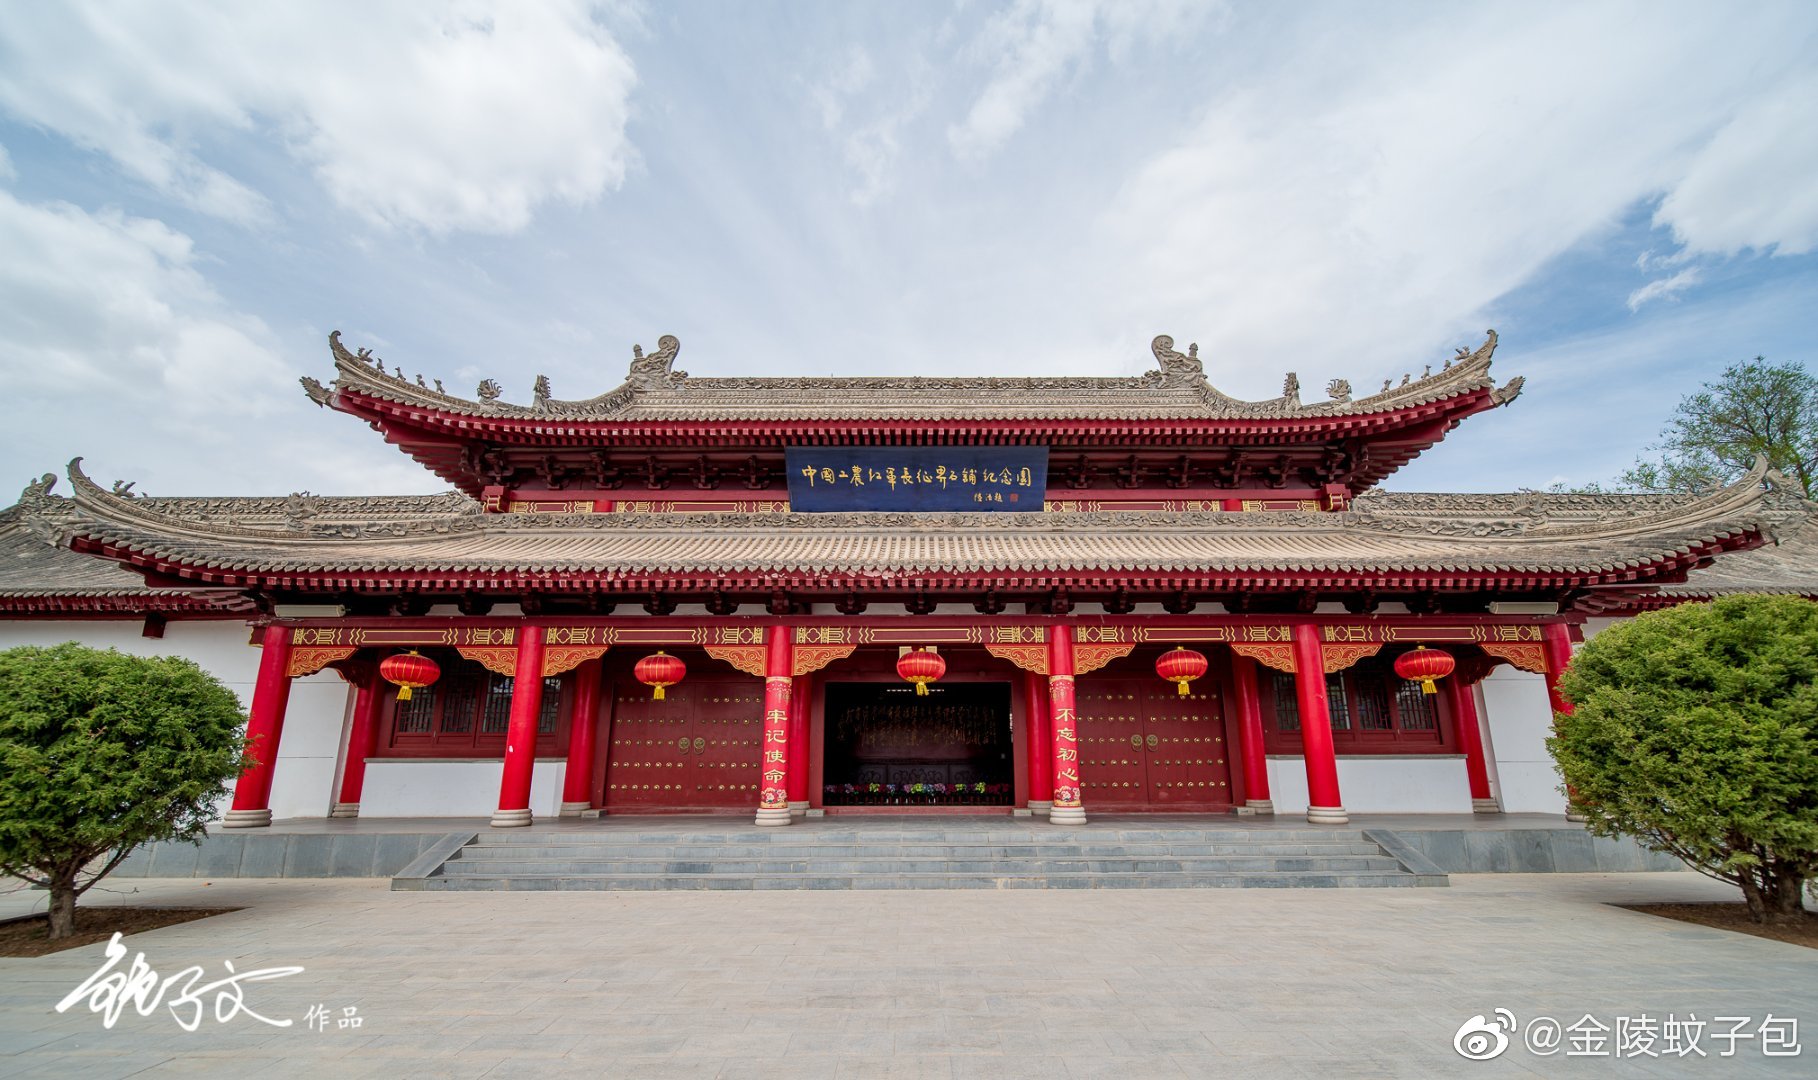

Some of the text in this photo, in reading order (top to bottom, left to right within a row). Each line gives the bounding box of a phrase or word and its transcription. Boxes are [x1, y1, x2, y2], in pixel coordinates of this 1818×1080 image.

[763, 708, 788, 784] 牢记使命
[1054, 707, 1079, 782] 不忘初心
